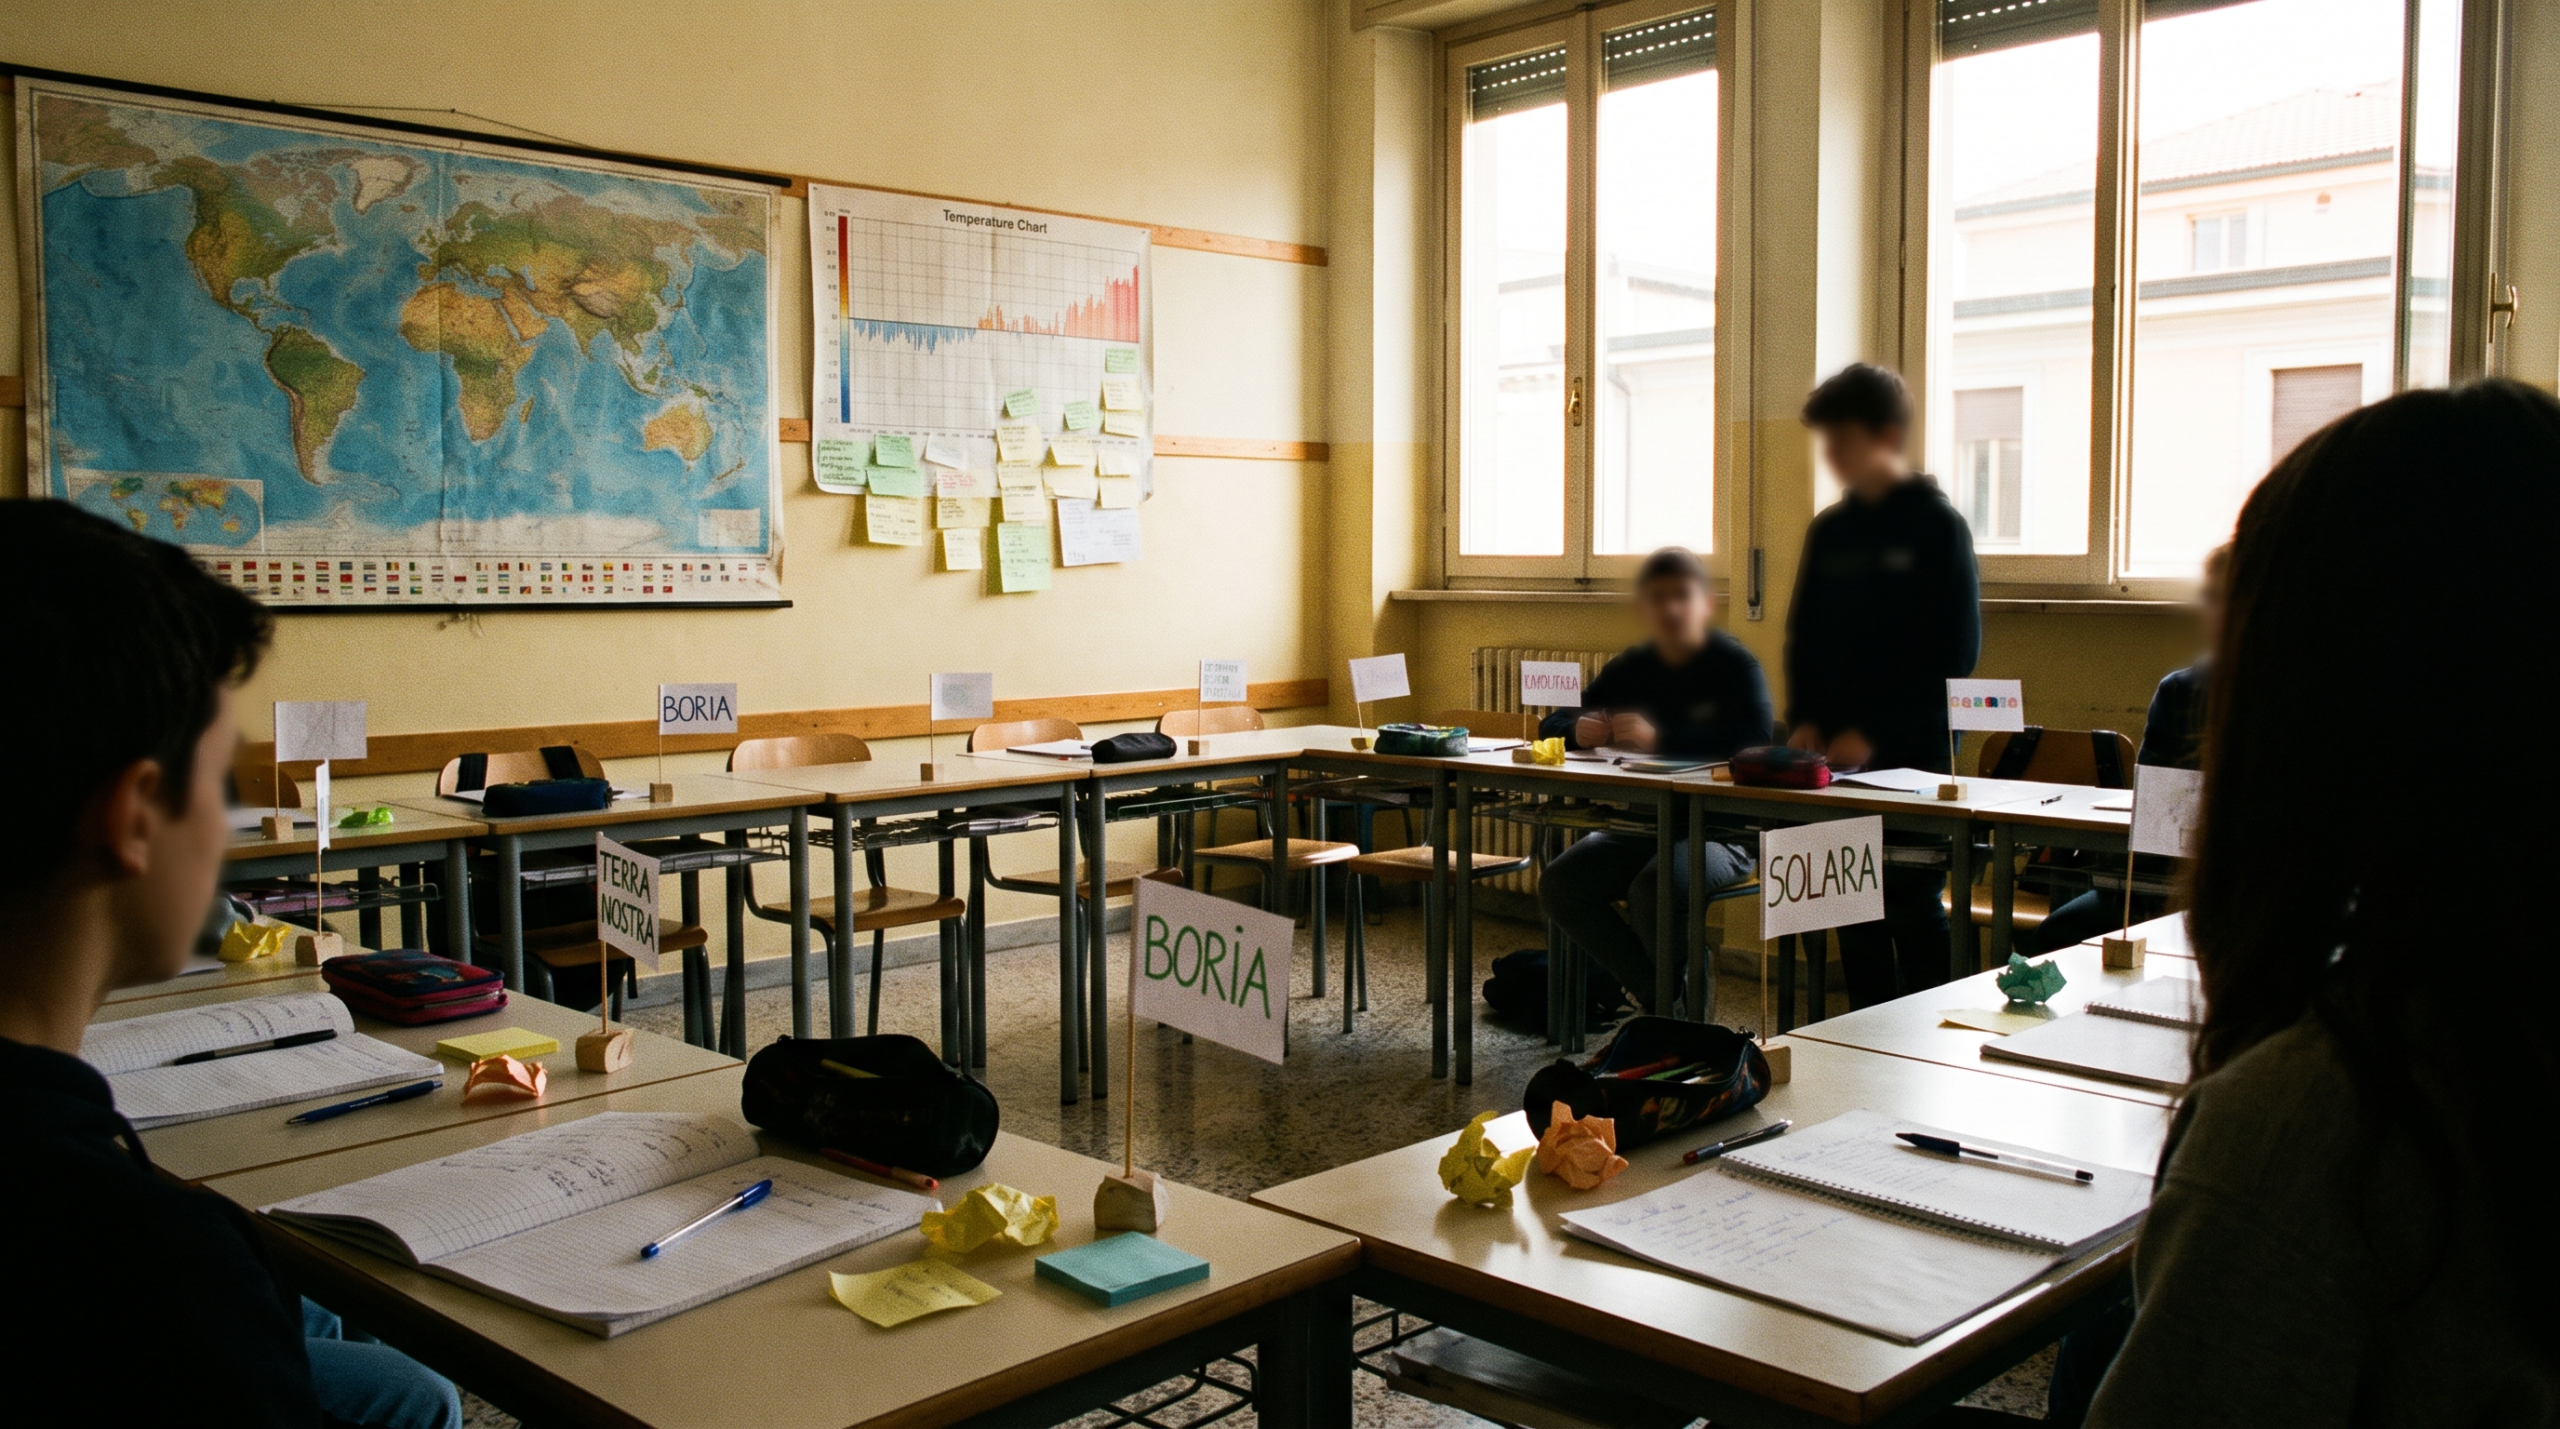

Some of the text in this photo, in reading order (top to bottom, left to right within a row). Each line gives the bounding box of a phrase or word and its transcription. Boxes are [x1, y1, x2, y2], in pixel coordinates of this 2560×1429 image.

[943, 209, 1048, 234] Temperature Chart
[663, 695, 733, 723] BORIA
[599, 850, 651, 905] TERRA
[1767, 842, 1878, 908] SOLARA
[601, 892, 655, 954] NOSTRA
